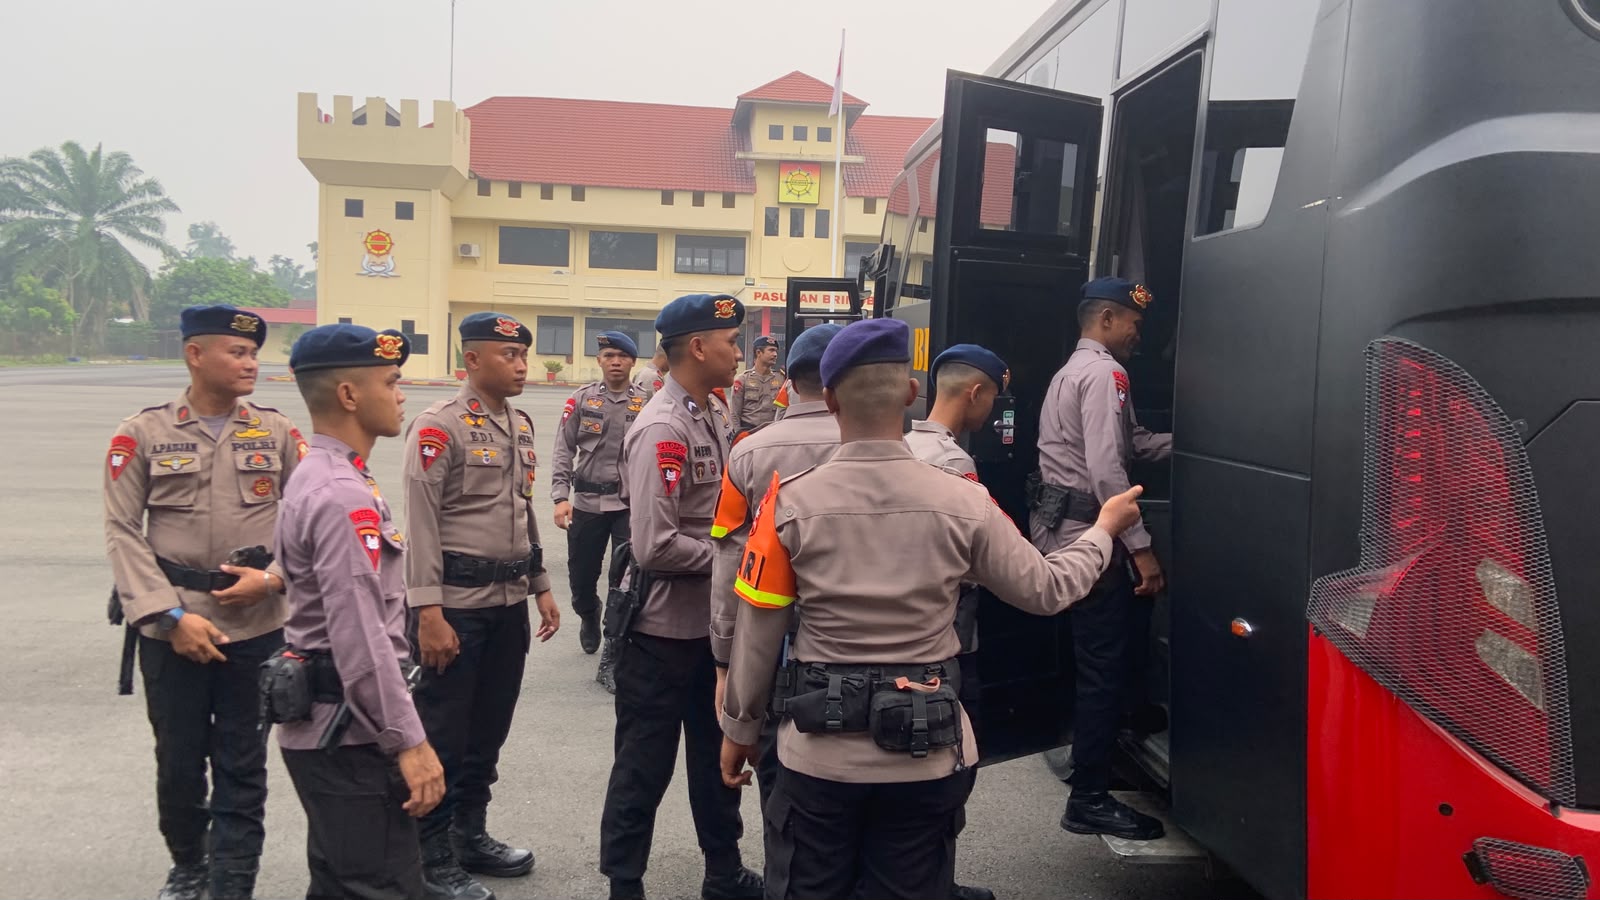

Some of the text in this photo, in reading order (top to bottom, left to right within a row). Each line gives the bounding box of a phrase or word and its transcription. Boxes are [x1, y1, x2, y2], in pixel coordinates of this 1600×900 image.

[754, 291, 874, 305] PASUAN BRIB
[470, 431, 494, 442] EDI
[231, 441, 277, 452] POLRI
